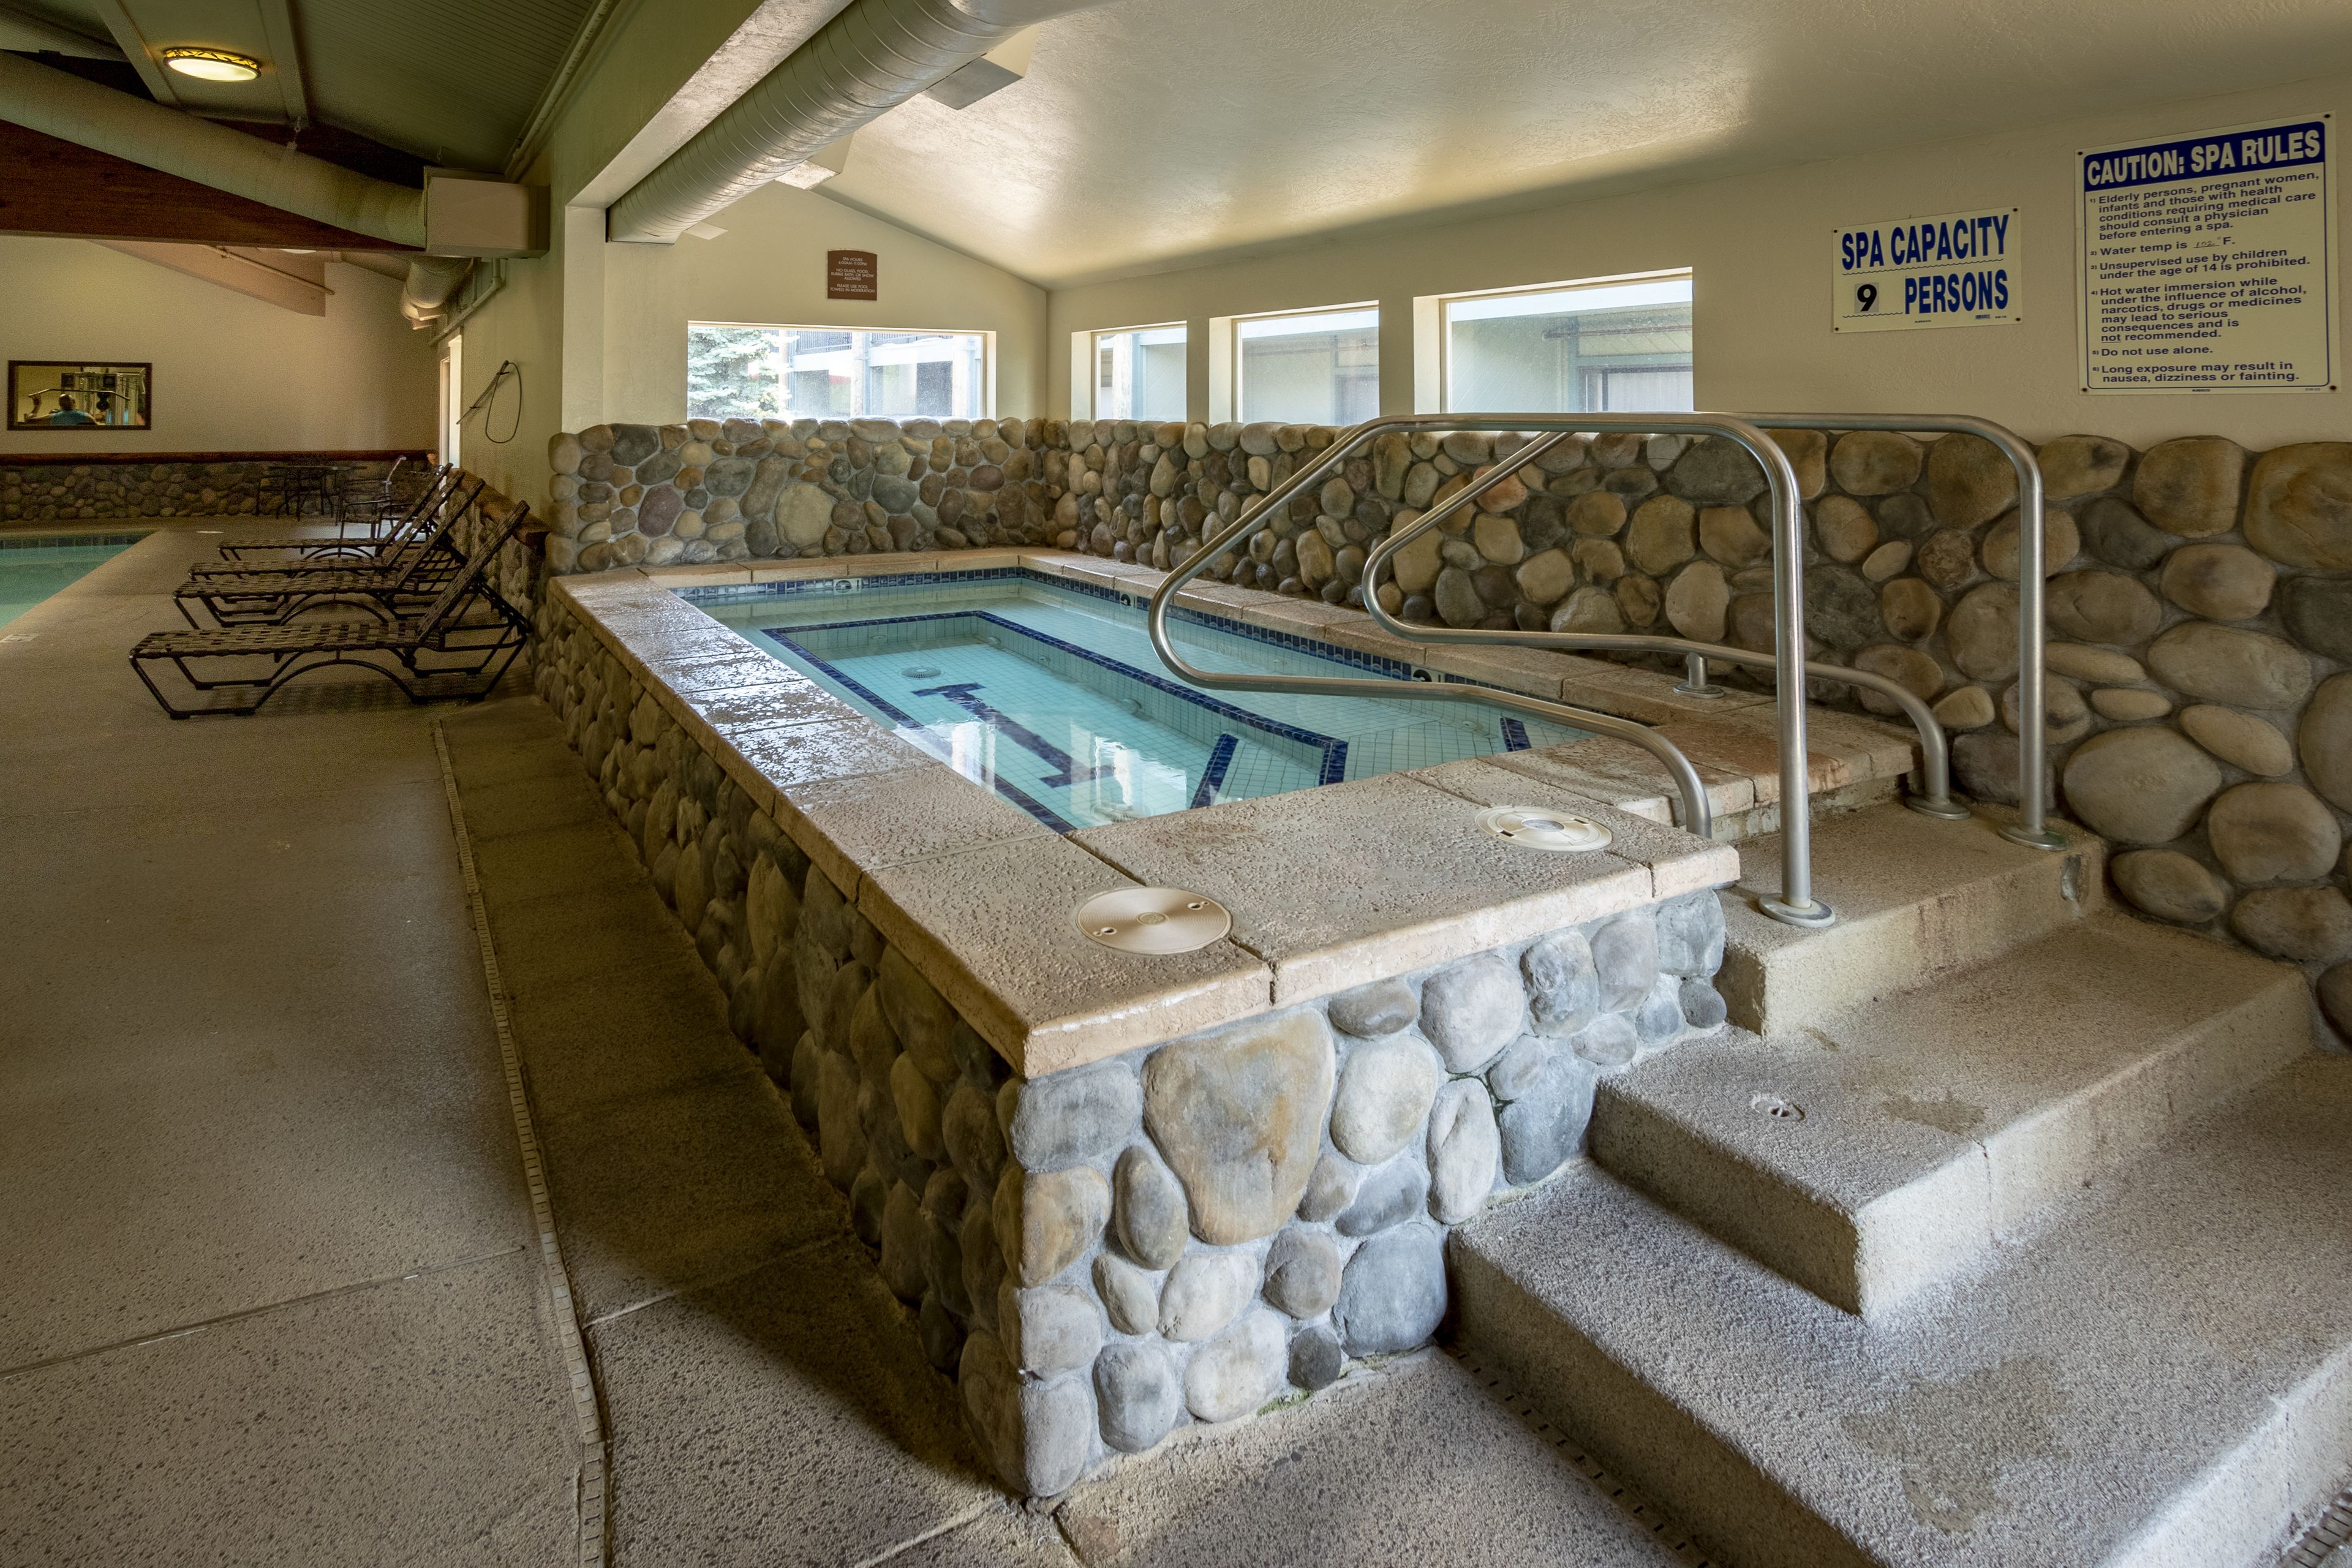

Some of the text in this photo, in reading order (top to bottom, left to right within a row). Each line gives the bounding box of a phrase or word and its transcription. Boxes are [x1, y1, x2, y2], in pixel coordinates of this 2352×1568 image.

[2087, 129, 2321, 186] CAUTION: SPA RULES
[2098, 192, 2140, 204] Elderly
[2144, 187, 2197, 201] persons,
[2201, 178, 2261, 194] pregnant
[2264, 173, 2319, 184] women,
[2098, 185, 2282, 213] infants and those with health
[2099, 193, 2316, 222] conditions requiring medical care
[2100, 219, 2139, 232] should
[2143, 214, 2189, 227] consult
[2204, 208, 2269, 223] physician
[2099, 231, 2137, 240] before
[2140, 225, 2192, 236] entering
[2206, 222, 2233, 232] spa.
[1842, 214, 2009, 270] SPA CAPACITY
[2100, 246, 2136, 256] Water
[2139, 243, 2173, 252] temp
[2100, 256, 2182, 271] Unsupervised
[2212, 254, 2228, 262] by
[2232, 249, 2287, 260] children
[2100, 256, 2310, 279] under the age of 14 is prohibited.
[1856, 269, 2008, 314] 9 PERSONS
[2100, 288, 2122, 296] Hot
[2125, 285, 2161, 294] water
[2164, 281, 2236, 292] immersion
[2239, 277, 2278, 287] while
[2101, 296, 2138, 305] under
[2165, 292, 2226, 301] influence
[2230, 288, 2245, 298] of
[2248, 285, 2307, 296] alcohol,
[2101, 304, 2163, 314] narcotics,
[2166, 303, 2206, 311] drugs
[2228, 296, 2302, 307] medicines
[2101, 316, 2127, 325] may
[2131, 312, 2157, 322] lead
[2178, 311, 2228, 320] serious
[2101, 318, 2239, 333] consequences and is
[2101, 329, 2222, 342] not recommended.
[2173, 345, 2213, 354] alone.
[2101, 365, 2133, 375] Long
[2136, 365, 2197, 374] exposure
[2201, 364, 2230, 373] may
[2234, 361, 2275, 371] result
[2280, 361, 2293, 370] in
[2155, 373, 2217, 382] dizziness
[2239, 372, 2299, 382] fainting.
